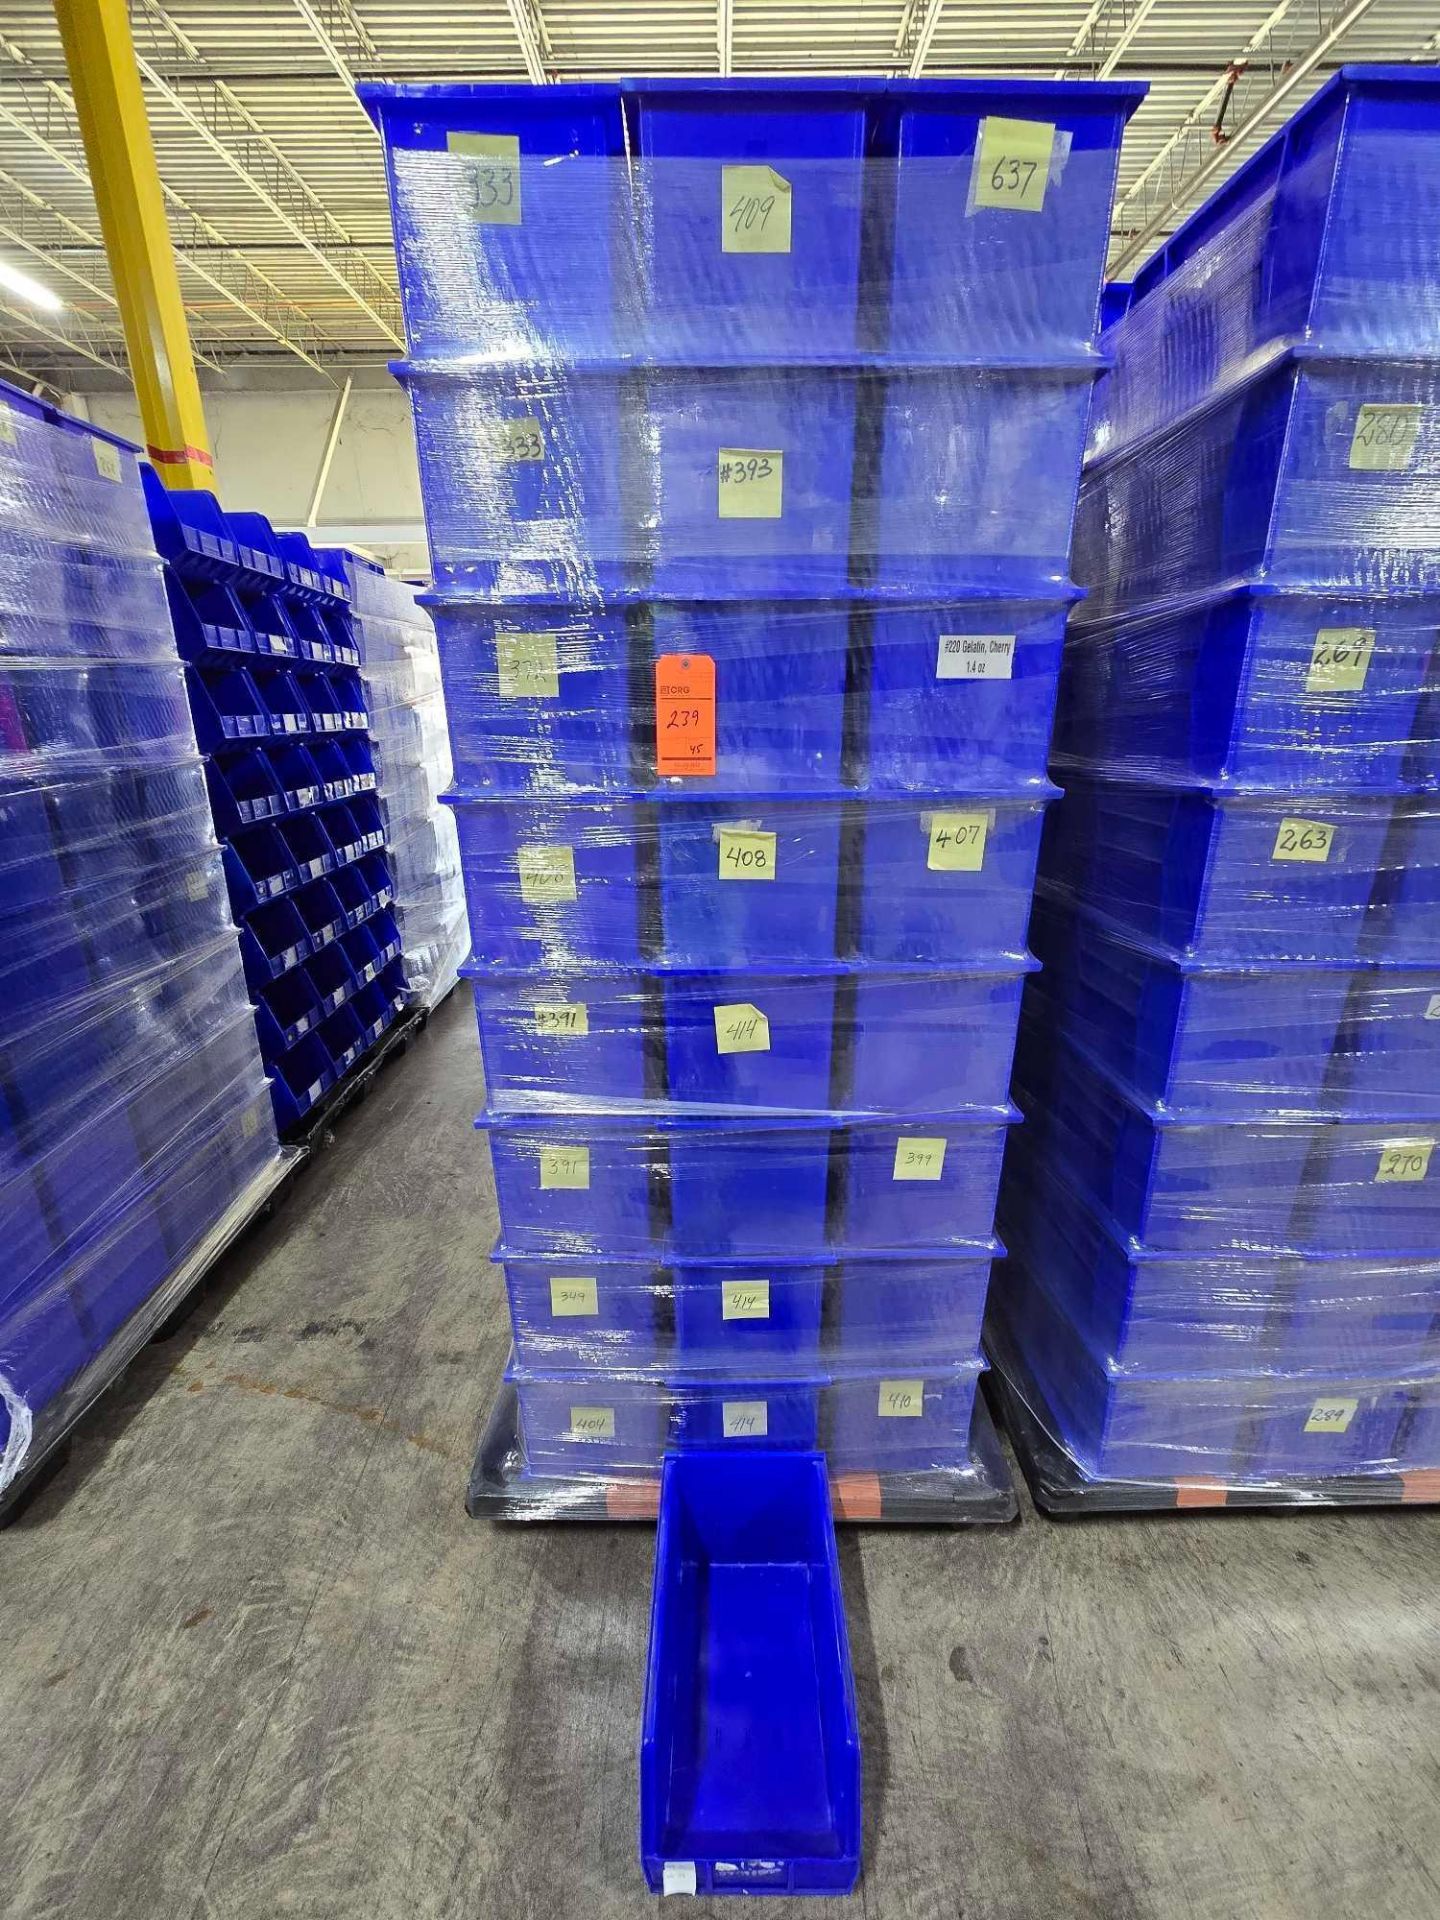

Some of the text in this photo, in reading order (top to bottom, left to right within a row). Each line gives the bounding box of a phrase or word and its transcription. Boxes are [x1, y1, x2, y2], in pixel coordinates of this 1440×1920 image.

[991, 155, 1038, 198] 637
[729, 195, 776, 232] 409
[1356, 412, 1409, 446] 280
[720, 458, 773, 483] #393
[990, 640, 1012, 656] Cherry
[967, 661, 986, 673] 1.4 oz
[667, 710, 699, 729] 239
[690, 743, 704, 755] 45
[936, 825, 980, 848] 407
[1280, 829, 1327, 851] 263
[726, 847, 766, 868] 408
[726, 1019, 758, 1041] 414
